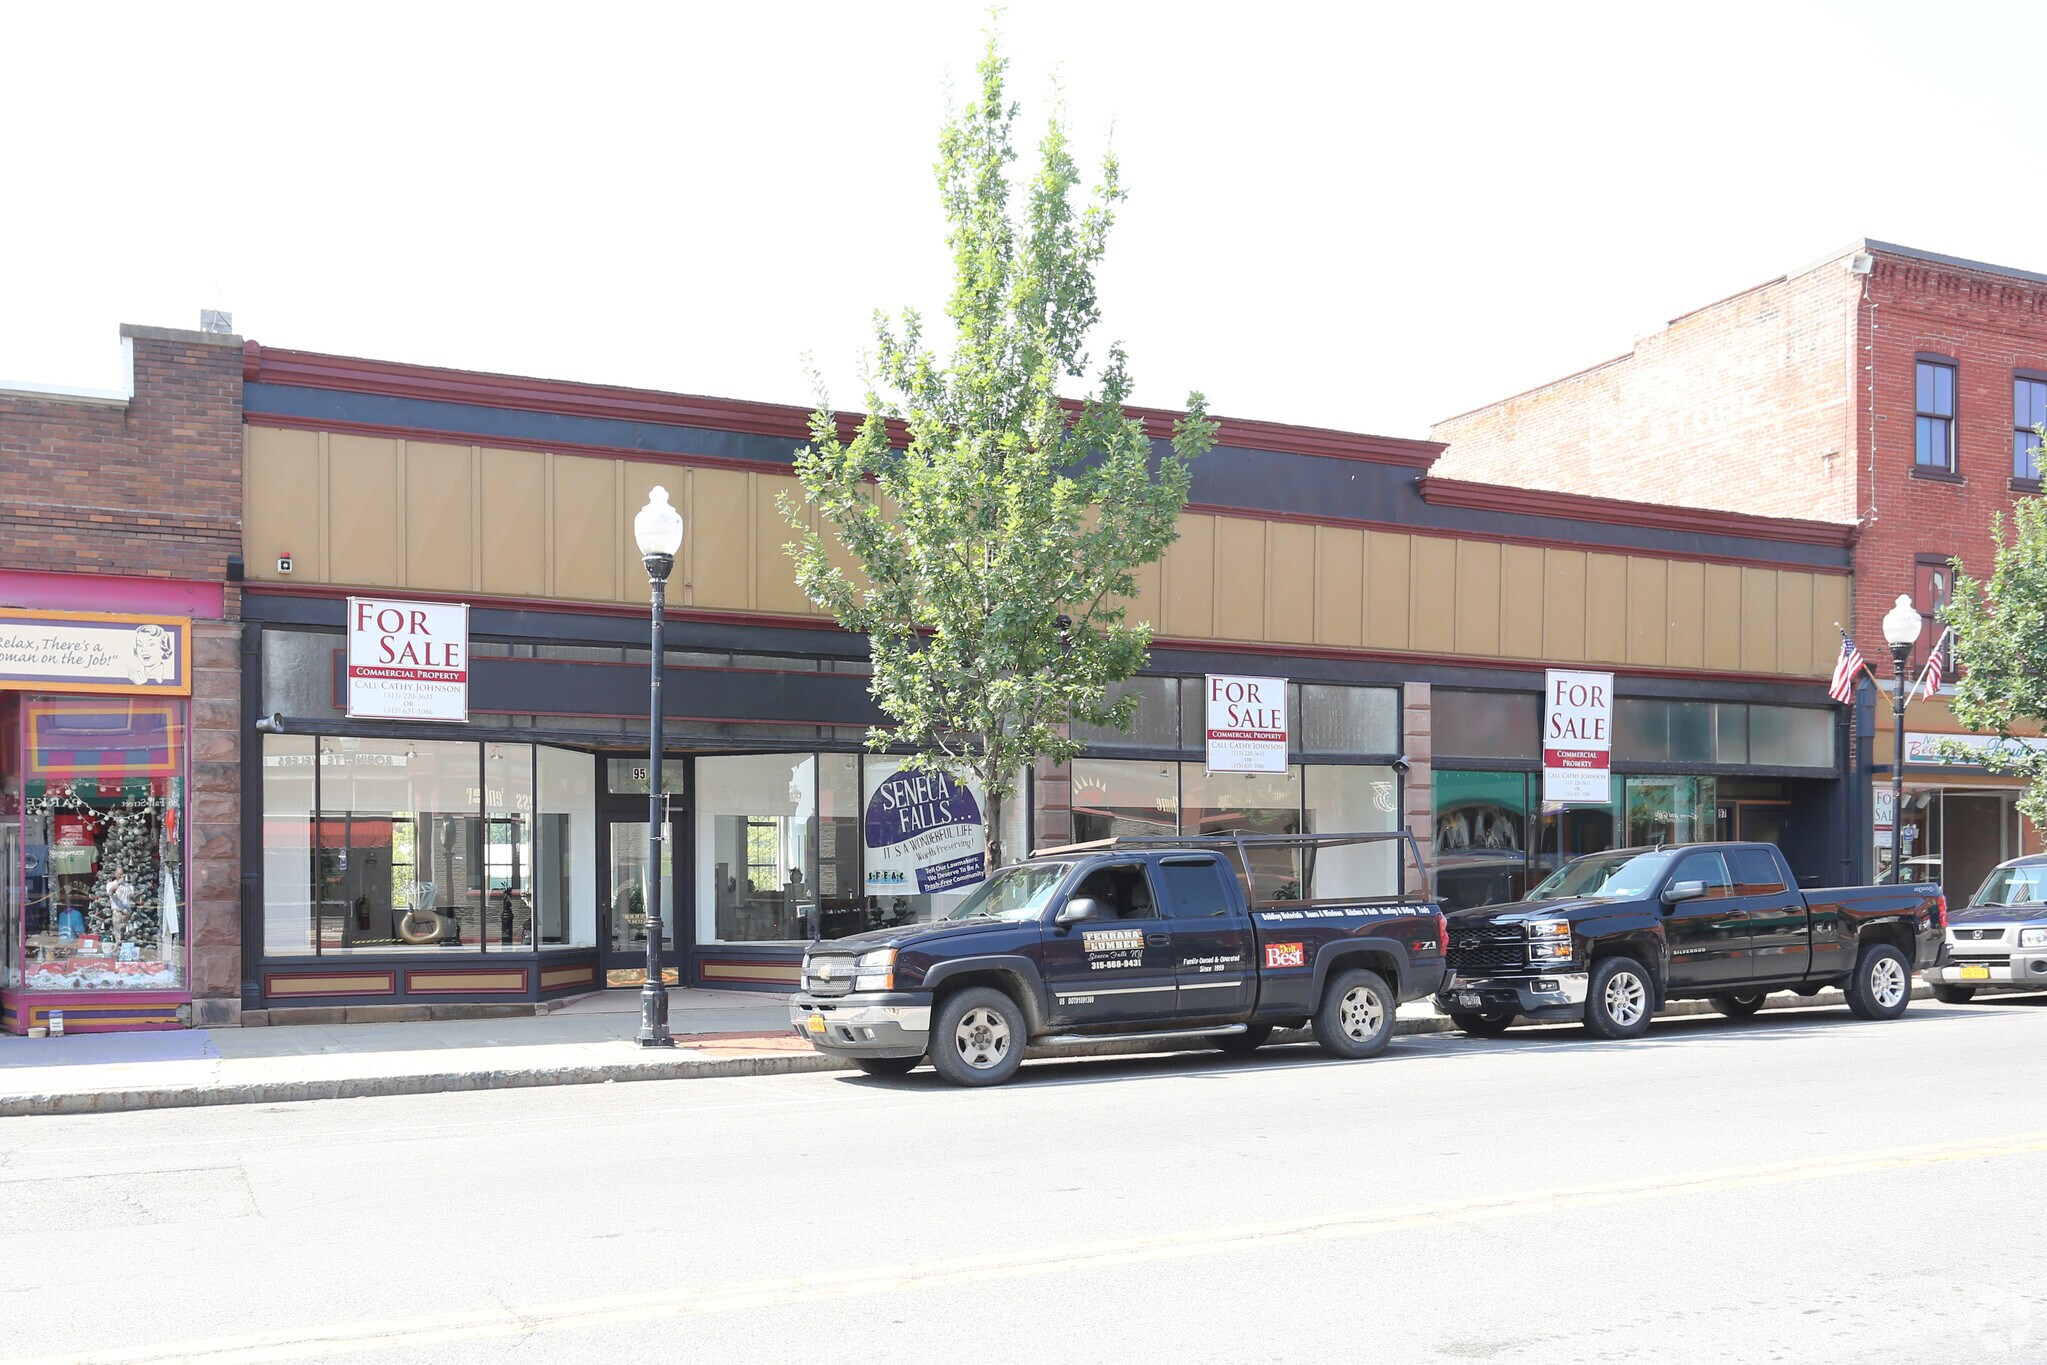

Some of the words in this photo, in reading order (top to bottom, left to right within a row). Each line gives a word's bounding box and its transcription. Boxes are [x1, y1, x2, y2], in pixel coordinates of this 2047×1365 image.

[355, 603, 432, 635] FOR
[42, 637, 91, 652] There's
[93, 643, 103, 652] a
[378, 635, 460, 667] SALE
[0, 652, 37, 662] oman
[41, 655, 57, 664] on
[61, 651, 84, 664] the
[356, 667, 415, 678] COMMERCIAL
[417, 670, 459, 680] PROPERTY
[355, 680, 378, 689] CALL
[381, 681, 413, 690] CATHY
[416, 683, 461, 693] JOHNSON
[1212, 679, 1262, 703] FOR
[1555, 680, 1606, 708] FOR
[1228, 704, 1281, 728] SALE
[1550, 712, 1605, 740] SALE
[1212, 730, 1252, 739] COMMERCIAL
[1253, 732, 1282, 740] PROPERTY
[1229, 742, 1252, 750] CATHY
[1556, 750, 1597, 758] COMMERCIAL
[633, 768, 646, 780] 95
[880, 773, 950, 811] SENECA
[1877, 791, 1893, 805] FO
[1875, 808, 1893, 821] SAL
[909, 827, 955, 852] WONDERFUL
[956, 824, 974, 837] LIFE
[915, 847, 937, 862] Worth
[935, 864, 946, 872] Our
[923, 878, 953, 891] Trash-Free
[952, 870, 984, 883] Community
[927, 874, 937, 882] We
[936, 869, 960, 879] Deserve
[1086, 930, 1140, 941] FERRARA
[1090, 940, 1138, 950] LUMBER
[1413, 940, 1437, 950] Z71
[1673, 947, 1706, 956] SILVERADO
[1087, 952, 1109, 962] Seneca
[1109, 950, 1127, 959] Falls
[1182, 957, 1199, 965] Family
[1220, 954, 1240, 963] Operated
[1266, 948, 1303, 967] Best
[1199, 965, 1212, 973] Since
